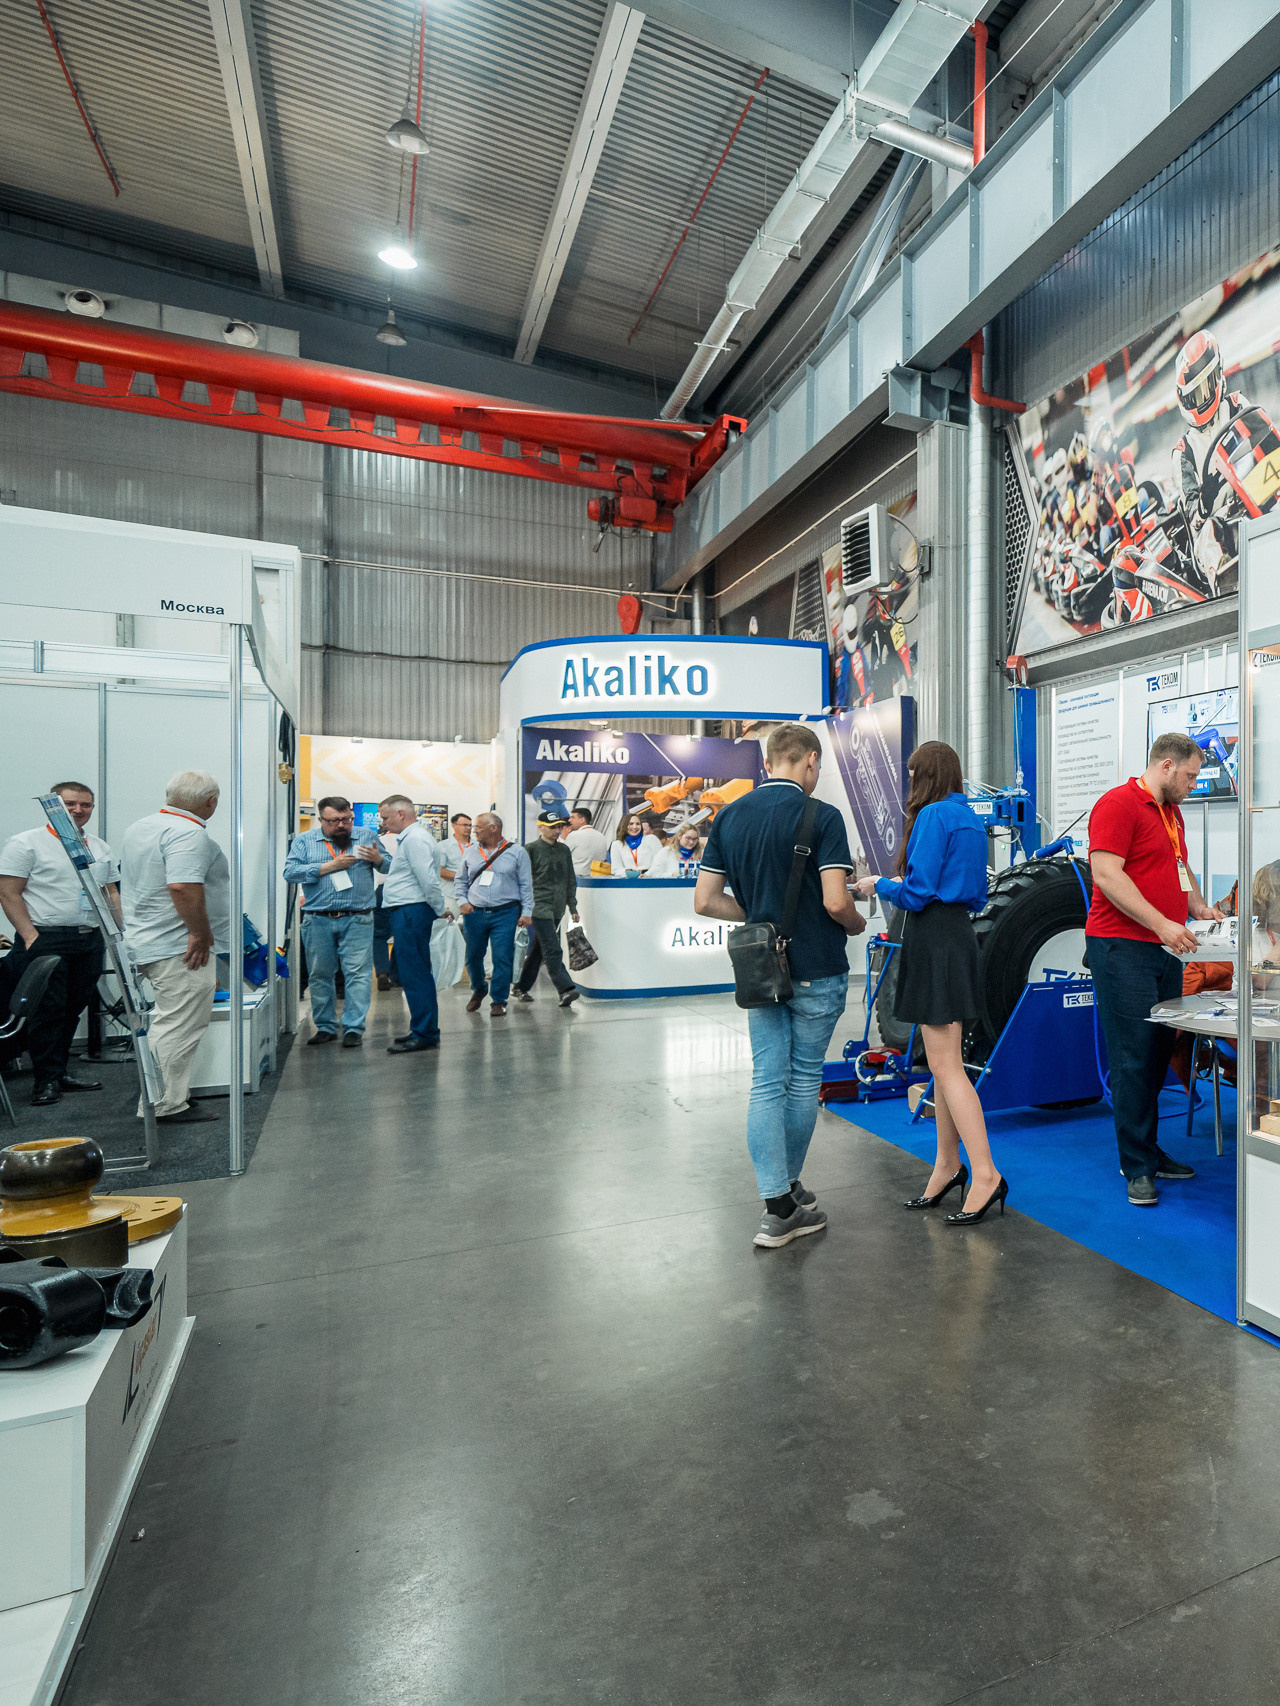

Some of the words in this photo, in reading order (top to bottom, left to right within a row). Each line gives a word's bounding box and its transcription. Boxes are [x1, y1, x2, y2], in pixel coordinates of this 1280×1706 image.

[161, 600, 224, 615] Москва
[561, 655, 709, 699] Akaliko
[536, 739, 630, 764] Akaliko
[672, 925, 731, 947] Akal
[1082, 994, 1094, 1002] TEKO
